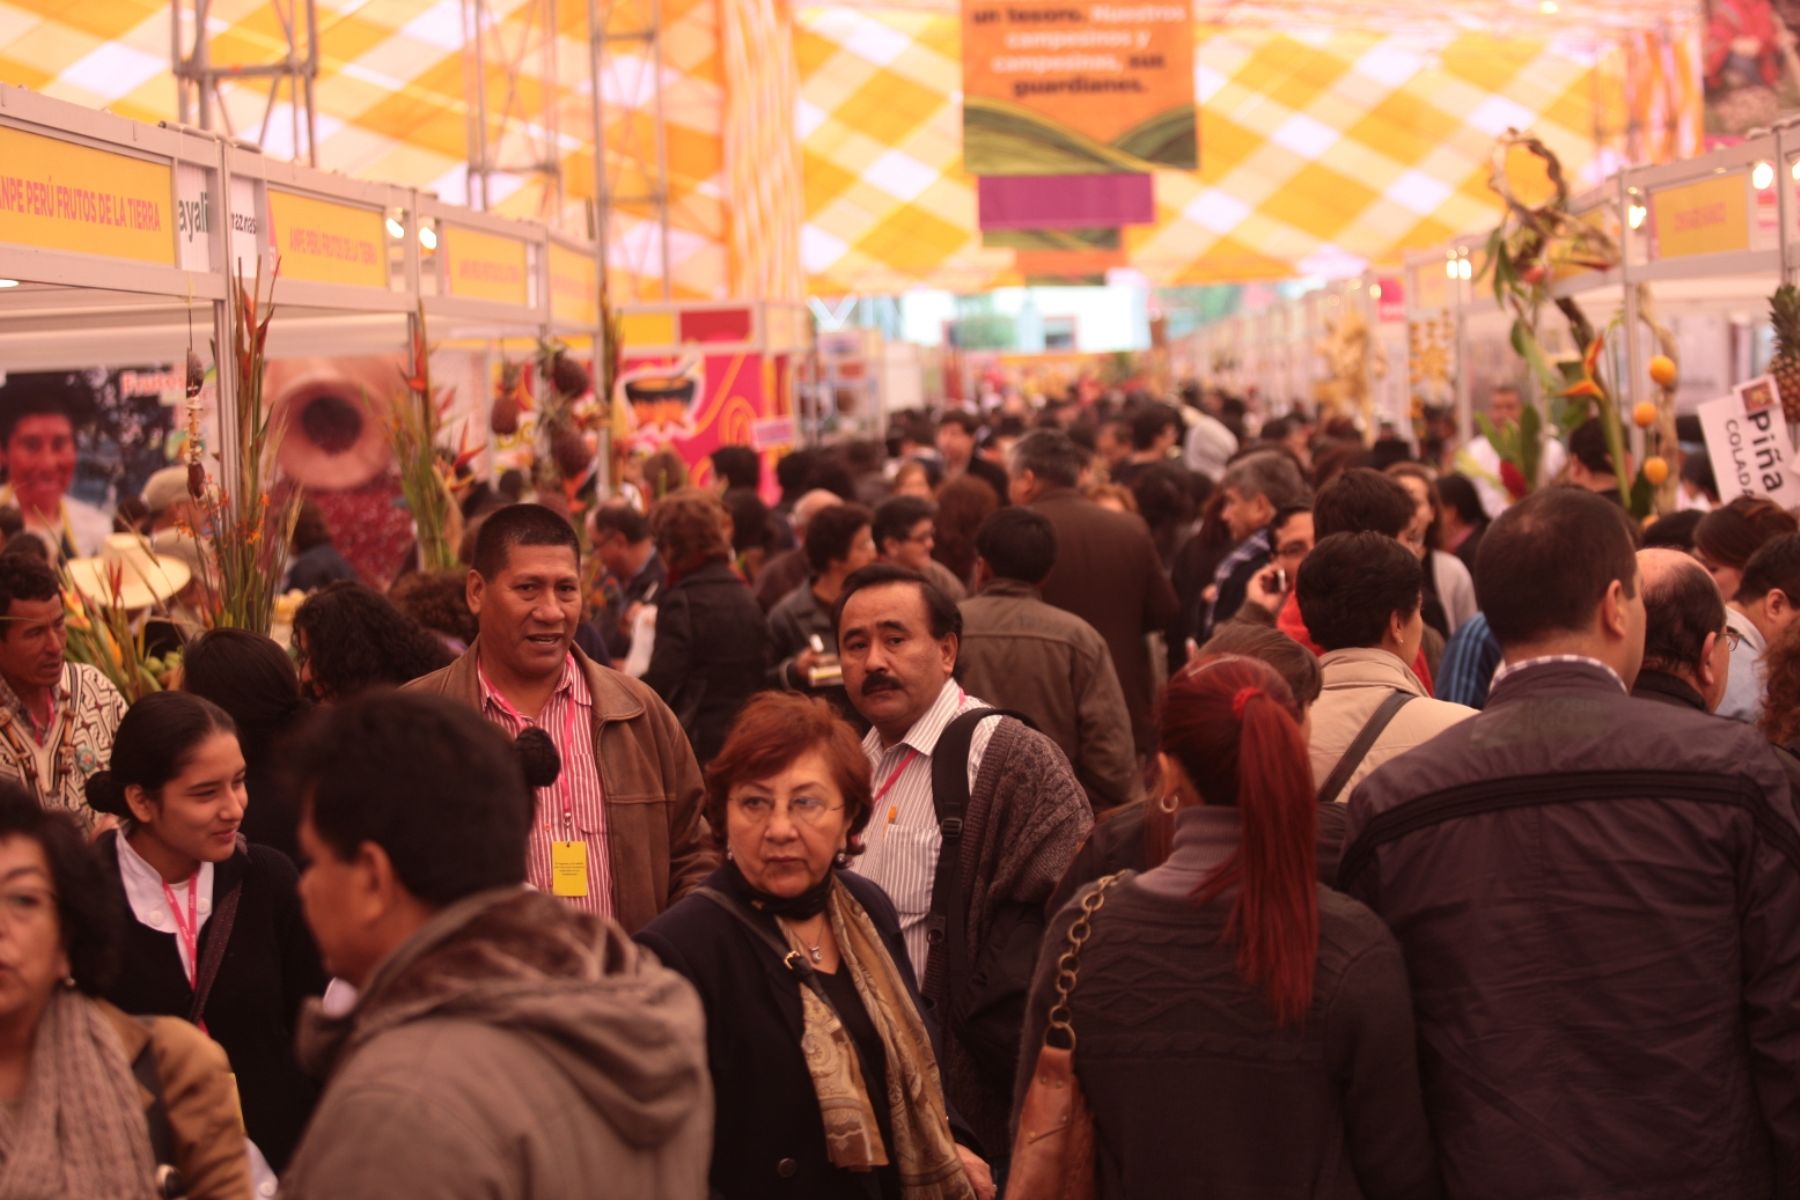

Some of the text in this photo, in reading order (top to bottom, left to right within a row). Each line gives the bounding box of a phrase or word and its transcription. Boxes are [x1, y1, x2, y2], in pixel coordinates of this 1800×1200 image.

[26, 175, 54, 217] PERÚ
[57, 185, 97, 223] FRUTOS
[98, 192, 112, 225] DE
[113, 194, 127, 227] LA
[127, 197, 161, 232] TIERRA
[1748, 410, 1783, 492] Piña
